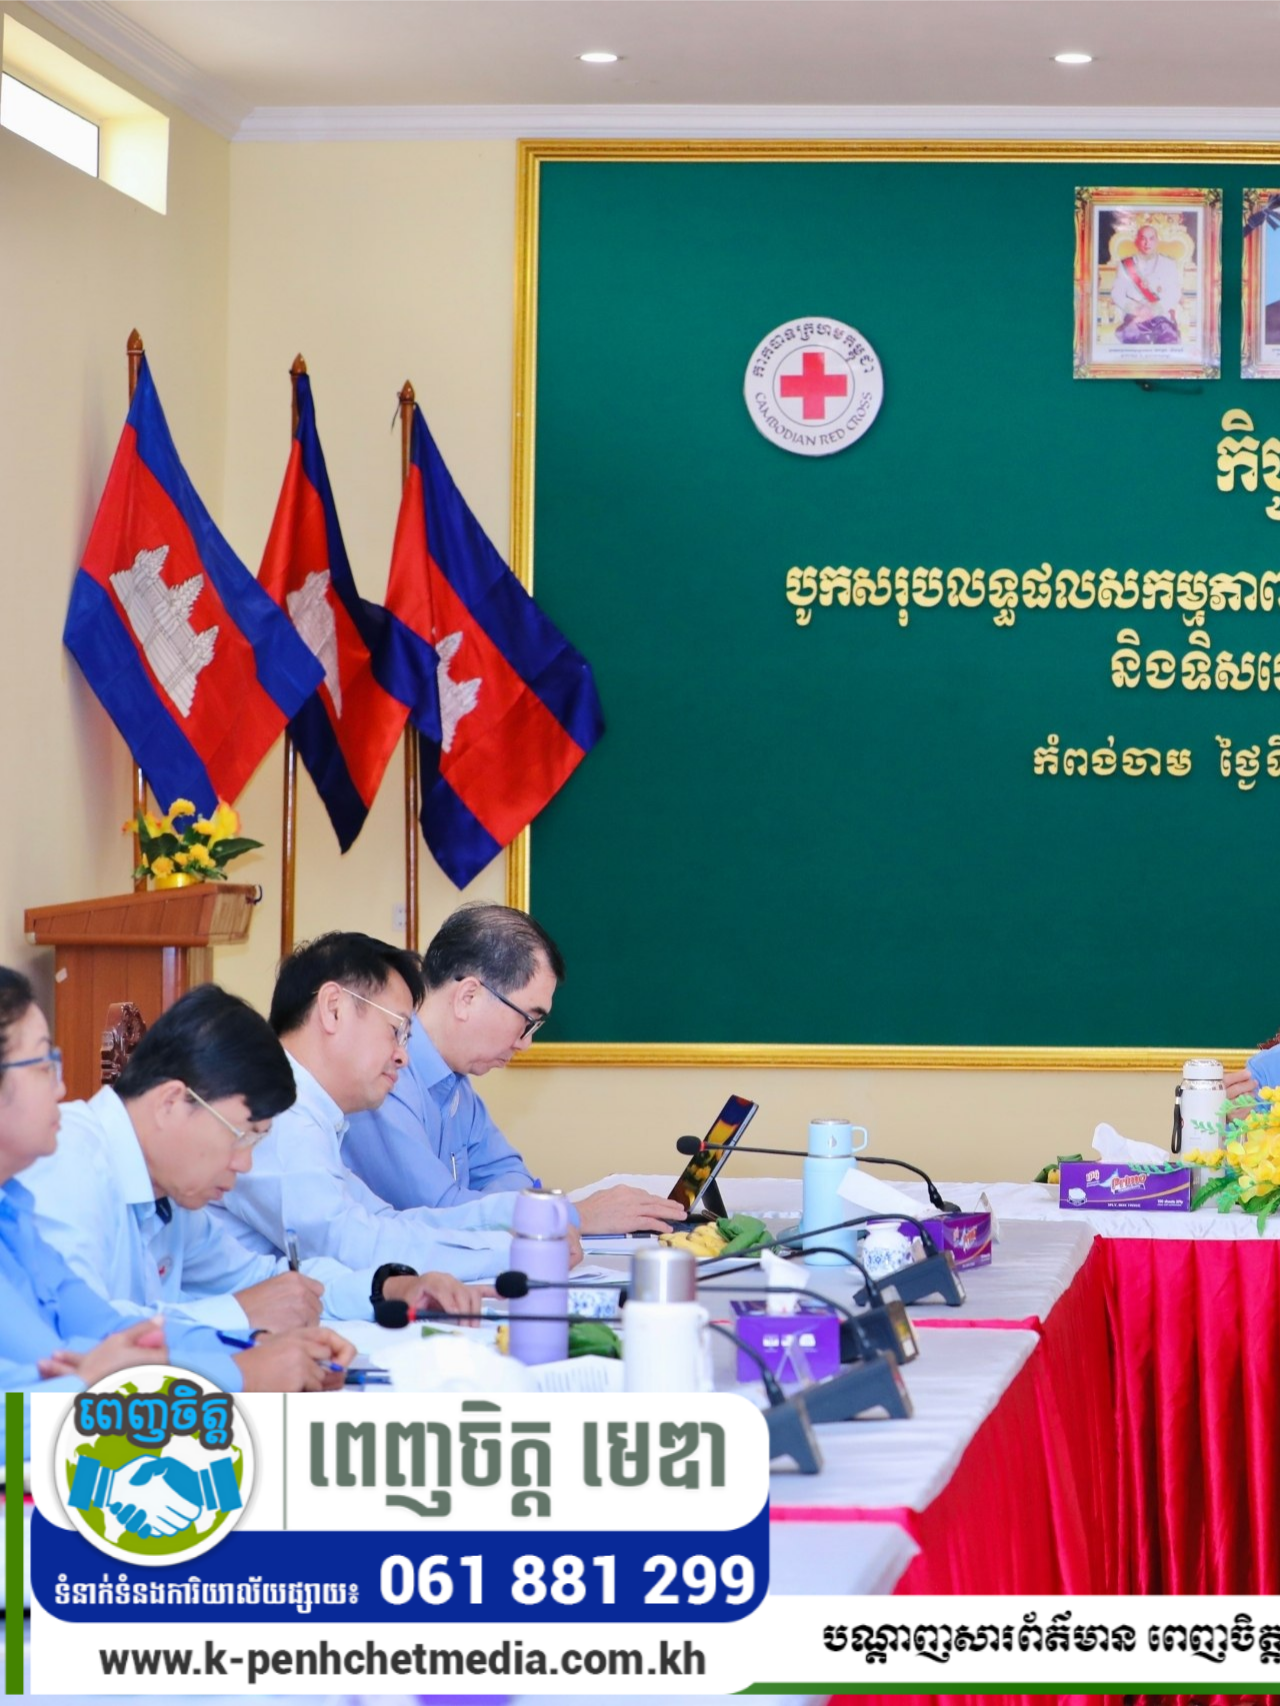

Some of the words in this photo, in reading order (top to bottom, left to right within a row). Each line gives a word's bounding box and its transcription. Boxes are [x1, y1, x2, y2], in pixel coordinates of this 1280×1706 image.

[755, 392, 817, 446] CAMBODIAN
[820, 428, 846, 445] RED
[846, 391, 873, 431] CROSS
[1033, 734, 1192, 777] កំពង់ចាម
